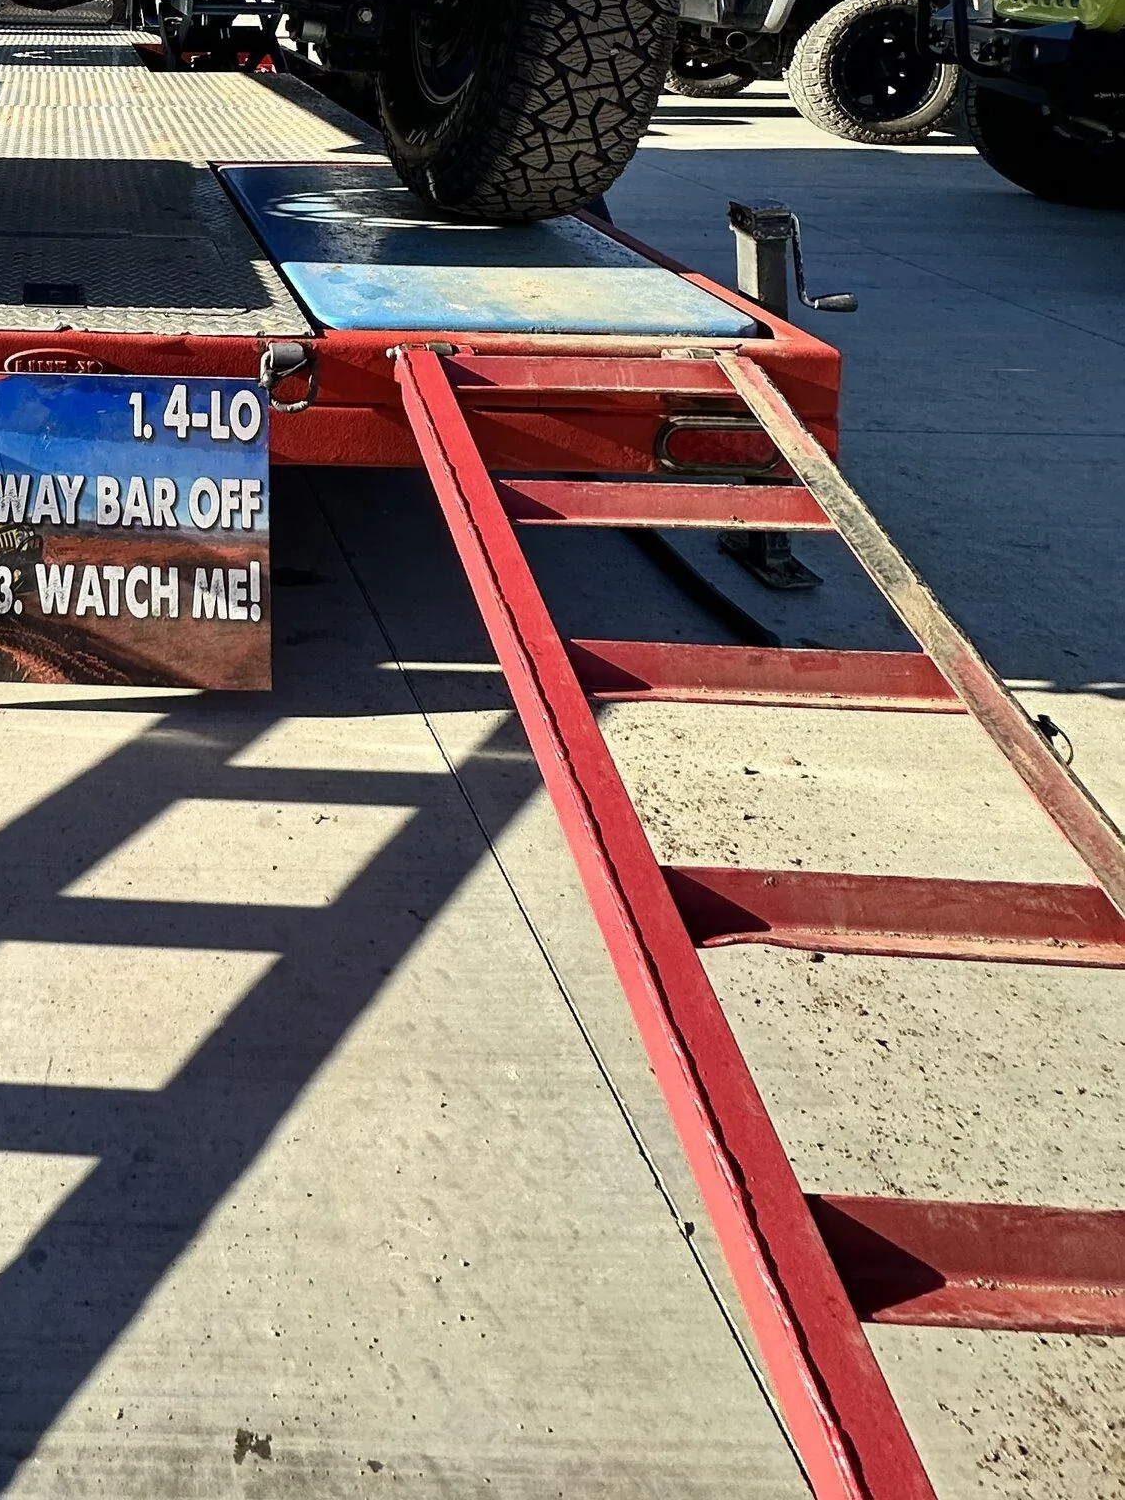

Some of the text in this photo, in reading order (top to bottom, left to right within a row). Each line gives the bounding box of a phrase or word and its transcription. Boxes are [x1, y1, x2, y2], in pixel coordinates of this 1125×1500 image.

[129, 384, 262, 442] 1. 4-LO
[96, 476, 177, 527] BAR
[188, 477, 262, 530] OFF
[35, 562, 179, 619] WATCH
[192, 561, 262, 622] ME!
